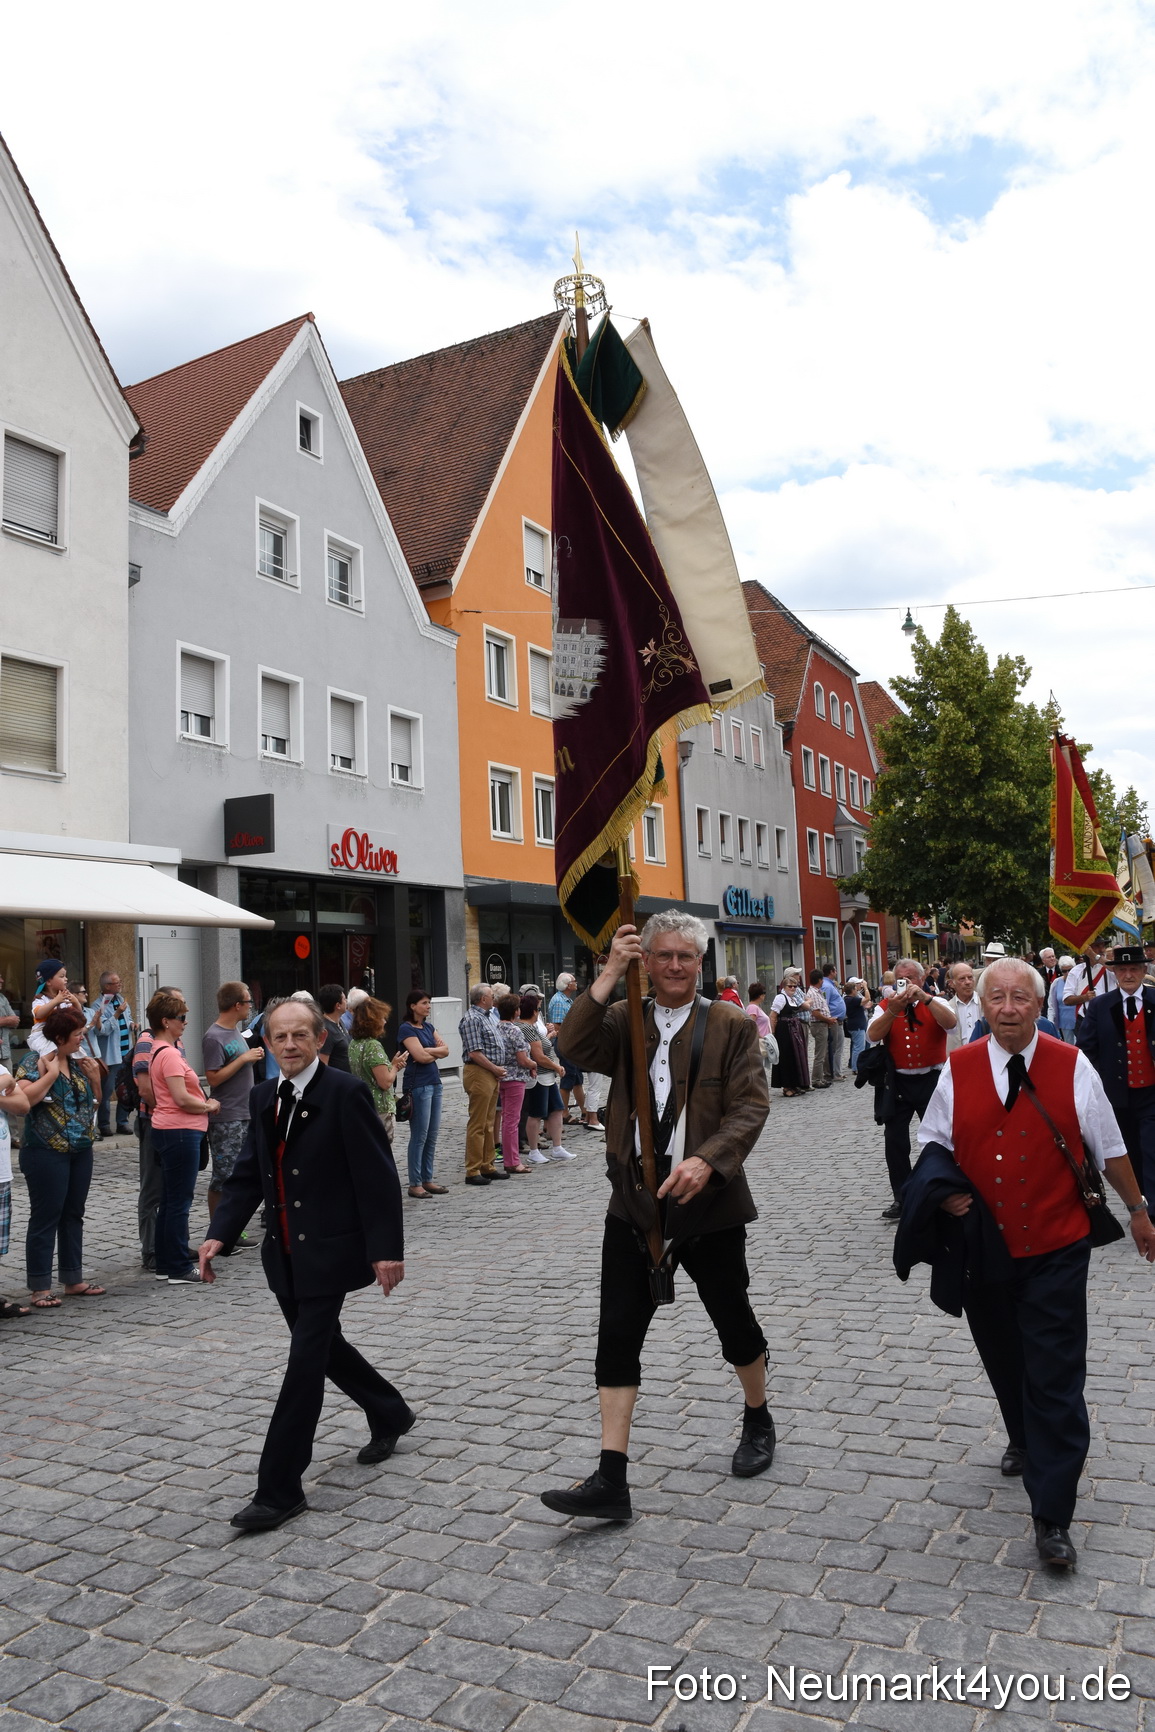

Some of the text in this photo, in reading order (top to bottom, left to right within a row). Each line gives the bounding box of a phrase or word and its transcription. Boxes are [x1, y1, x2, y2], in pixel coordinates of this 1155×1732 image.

[229, 832, 264, 849] s.Oliver
[331, 827, 400, 874] s.Oliver
[724, 885, 765, 917] Eilles
[170, 929, 177, 938] 29
